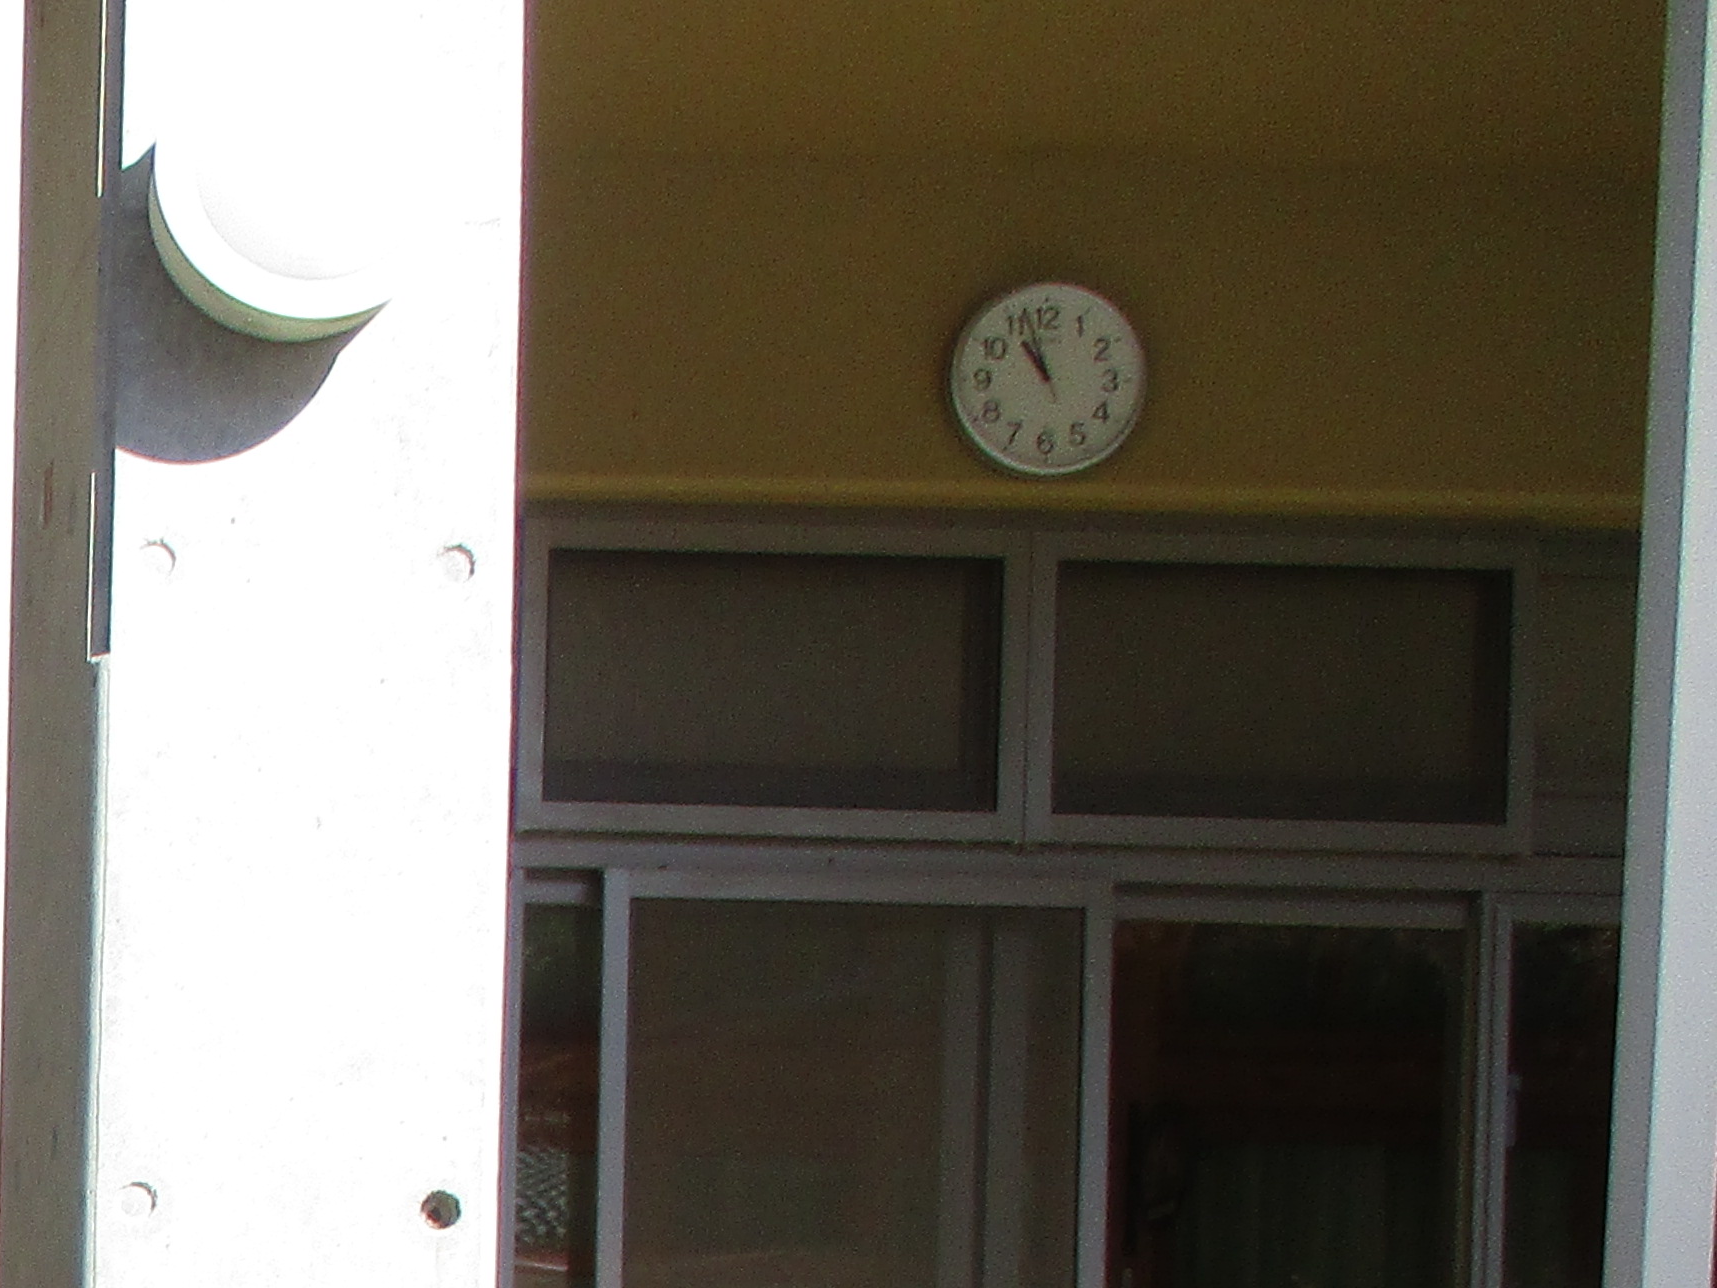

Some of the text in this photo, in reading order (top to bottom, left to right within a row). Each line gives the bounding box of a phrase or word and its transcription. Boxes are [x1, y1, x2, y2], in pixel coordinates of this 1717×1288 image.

[1036, 305, 1061, 330] 12
[1075, 315, 1085, 338] 1
[982, 337, 1006, 360] 10
[1093, 338, 1111, 362] 2
[973, 368, 992, 391] 9
[1101, 369, 1119, 393] 3
[981, 400, 1000, 423] 8
[1092, 402, 1110, 424] 4
[1007, 422, 1023, 446] 7
[1036, 431, 1055, 455] 6
[1069, 423, 1086, 446] 5
